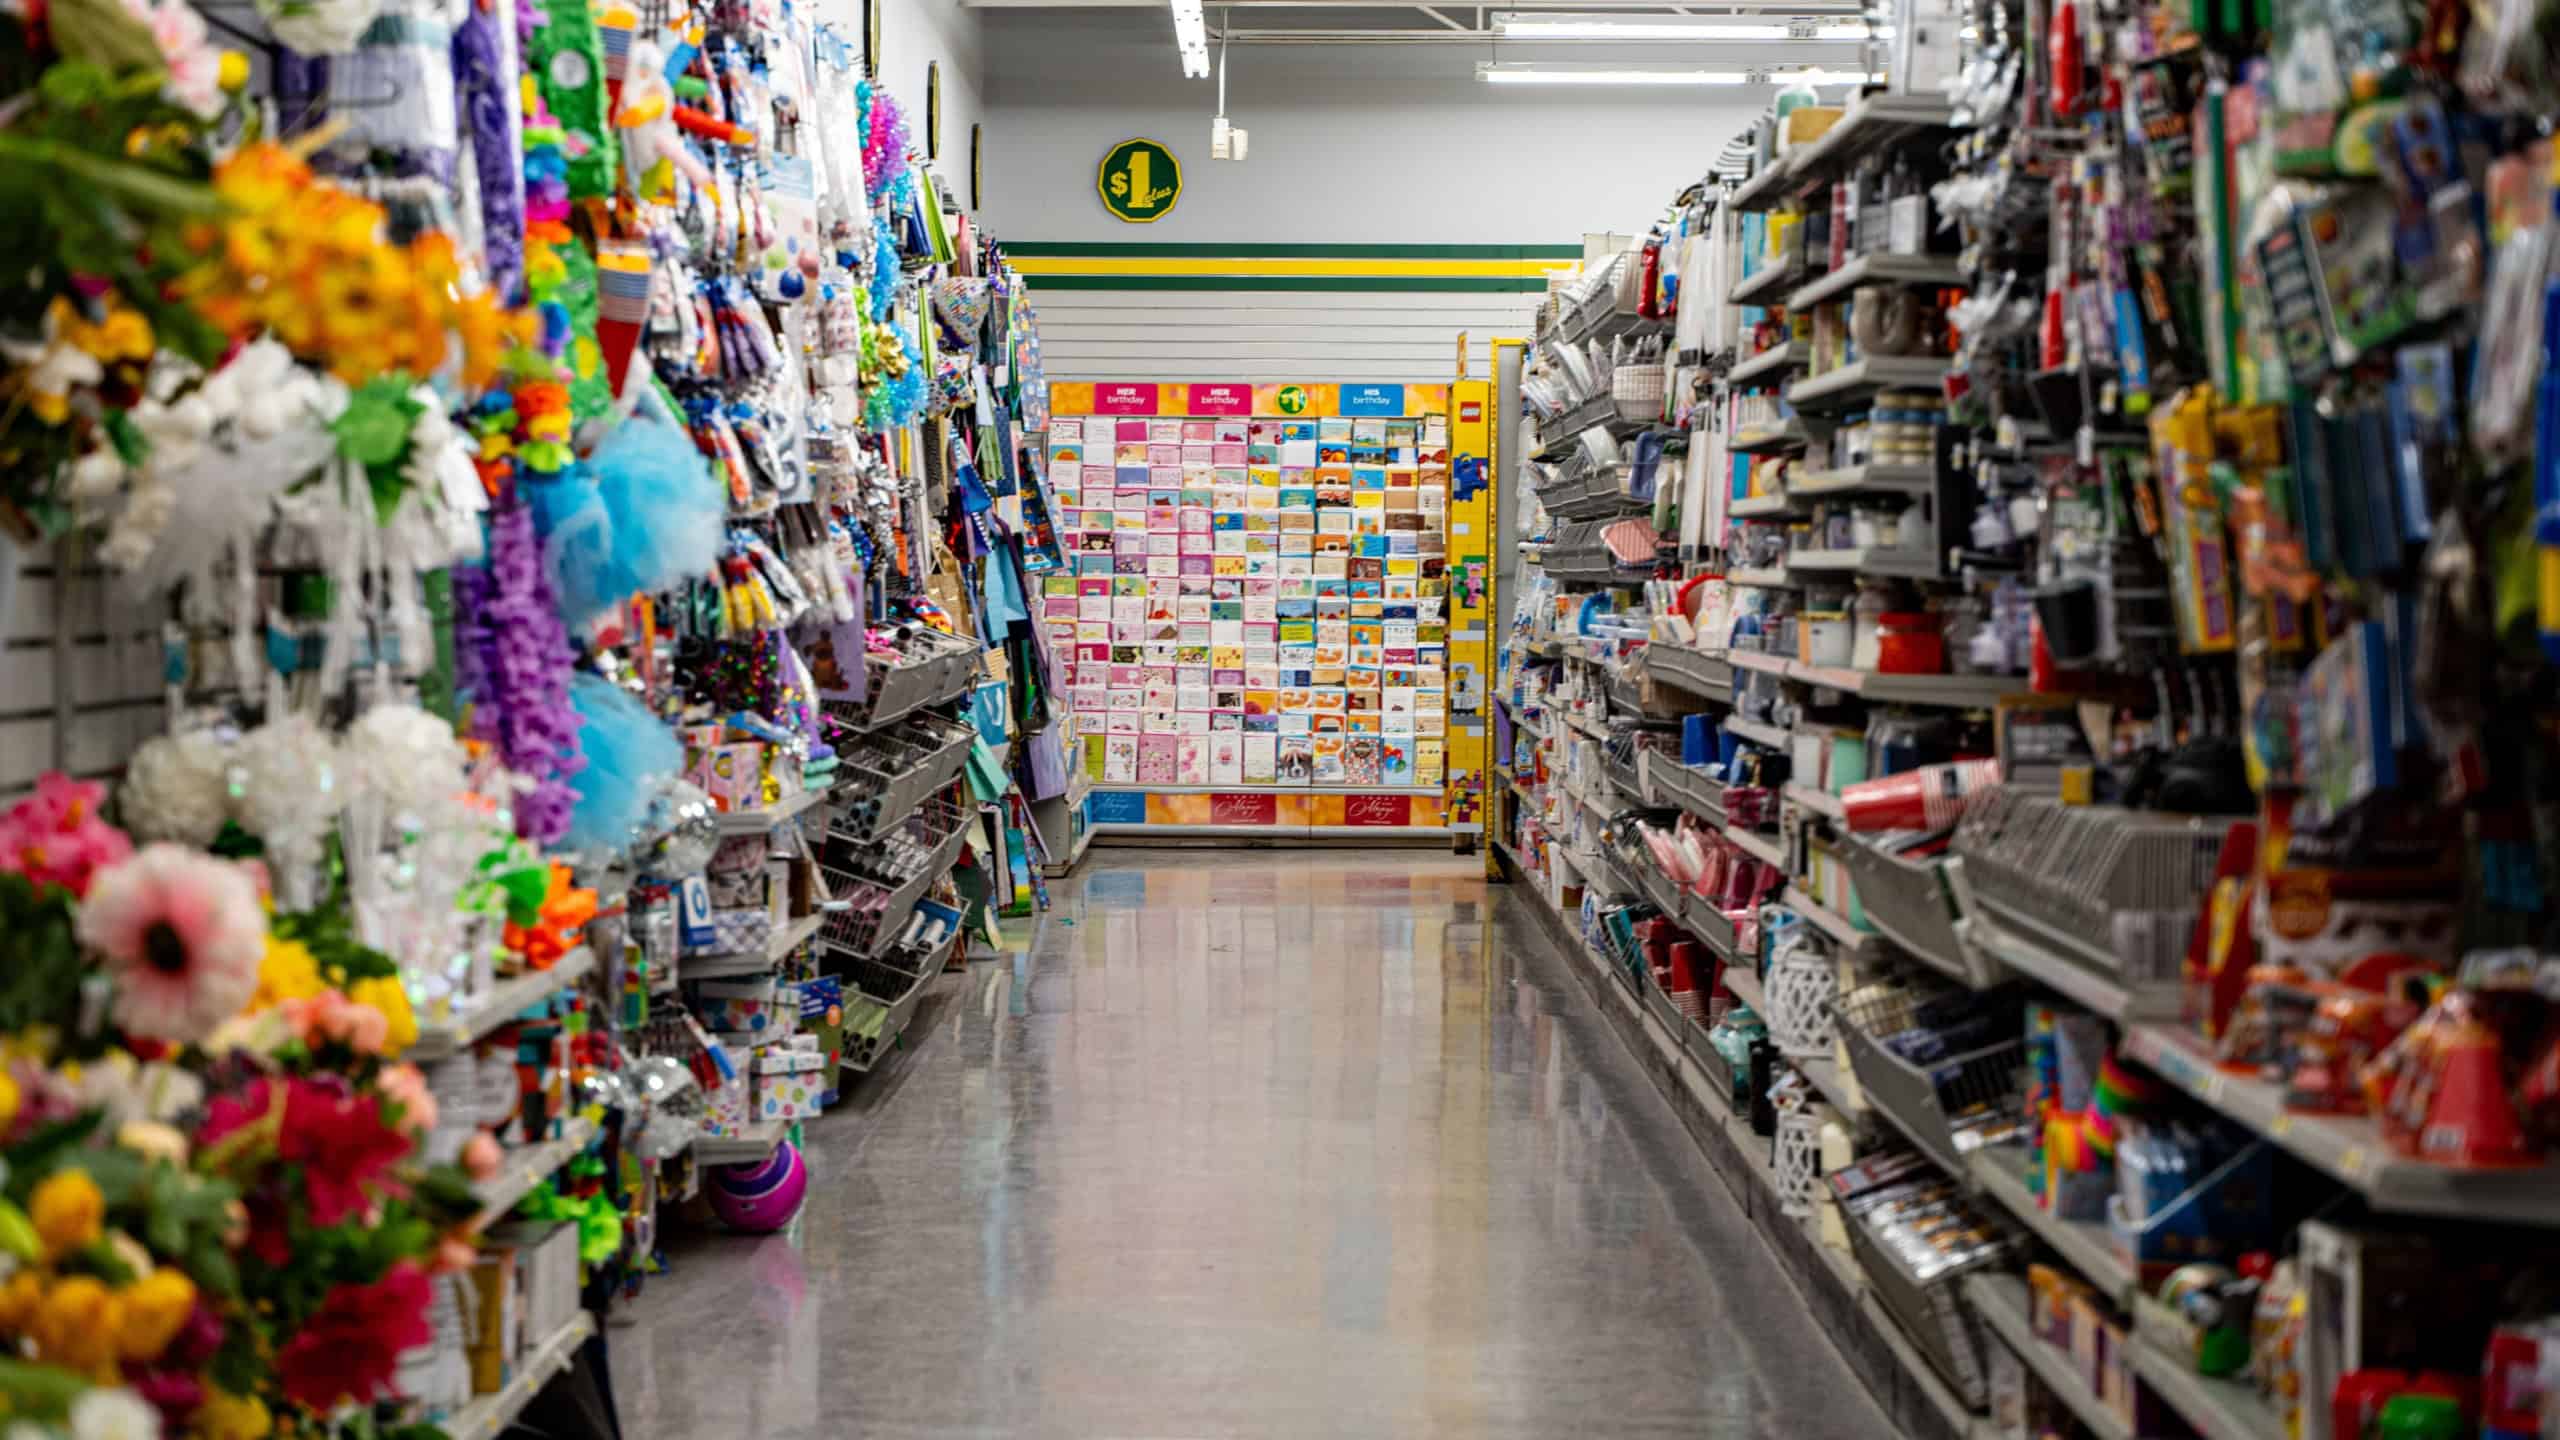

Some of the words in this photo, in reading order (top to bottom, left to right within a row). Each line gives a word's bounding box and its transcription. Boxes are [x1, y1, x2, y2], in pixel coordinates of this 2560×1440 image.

[1110, 151, 1154, 208] $1
[1107, 395, 1146, 406] birthday
[1200, 395, 1240, 406] birthday
[1352, 396, 1391, 406] birthday
